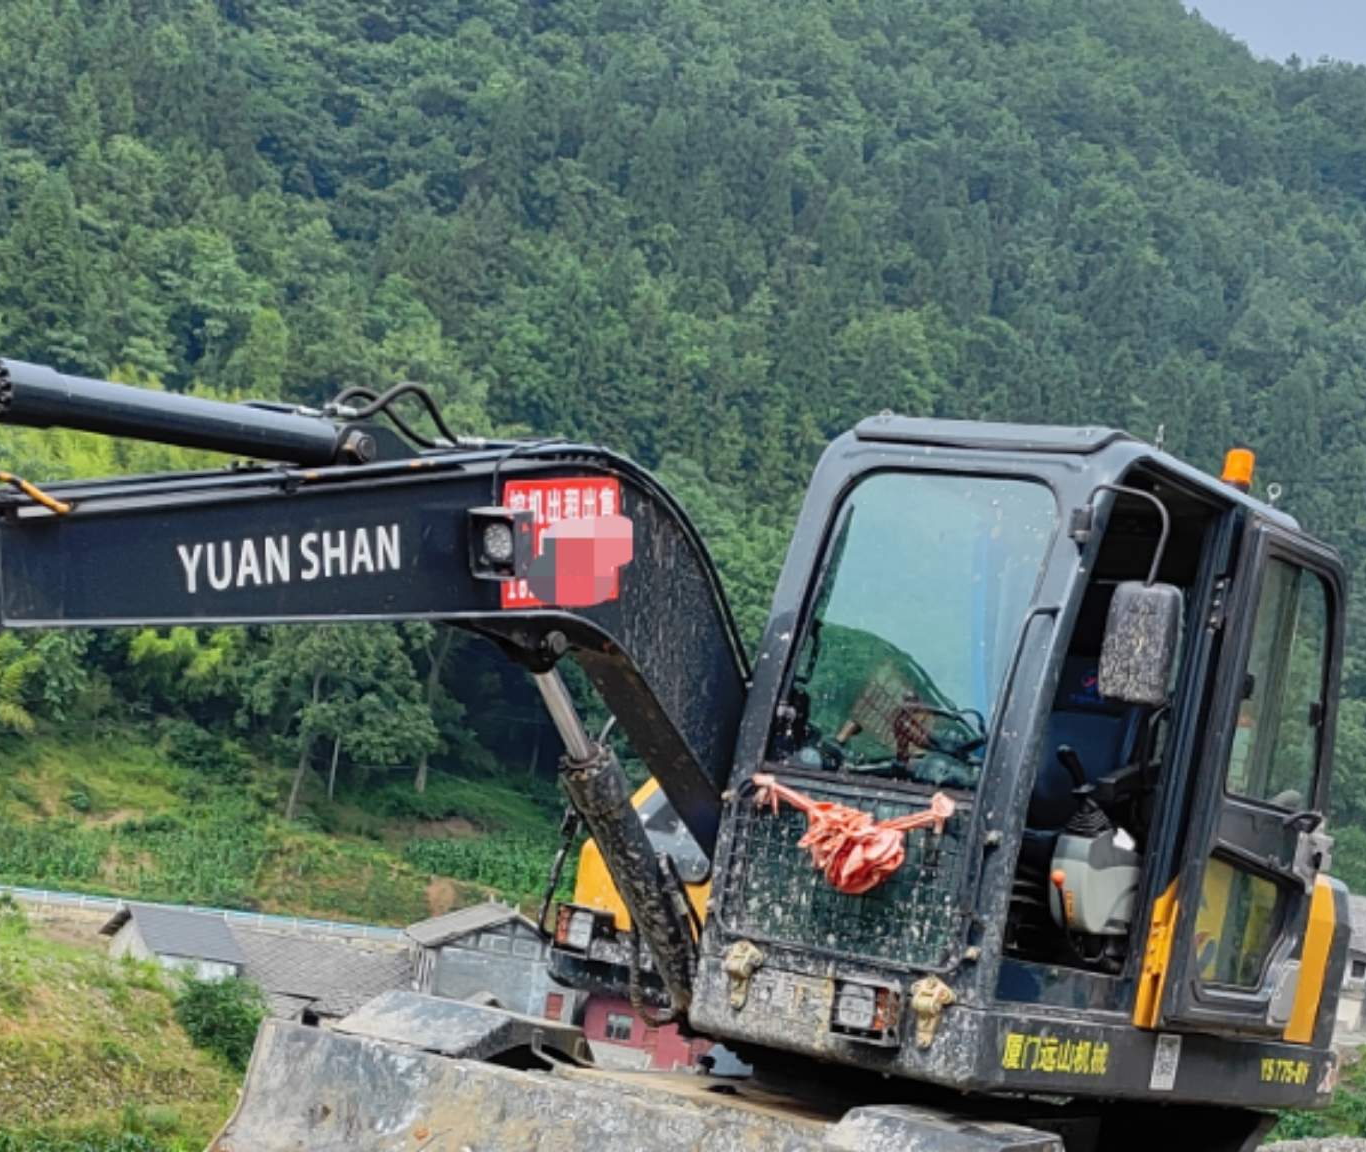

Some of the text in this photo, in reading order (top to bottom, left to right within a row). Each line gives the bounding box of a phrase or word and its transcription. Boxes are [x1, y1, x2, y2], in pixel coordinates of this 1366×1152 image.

[177, 523, 401, 594] YUAN SHAN
[1002, 1033, 1110, 1075] 厦门远山机械
